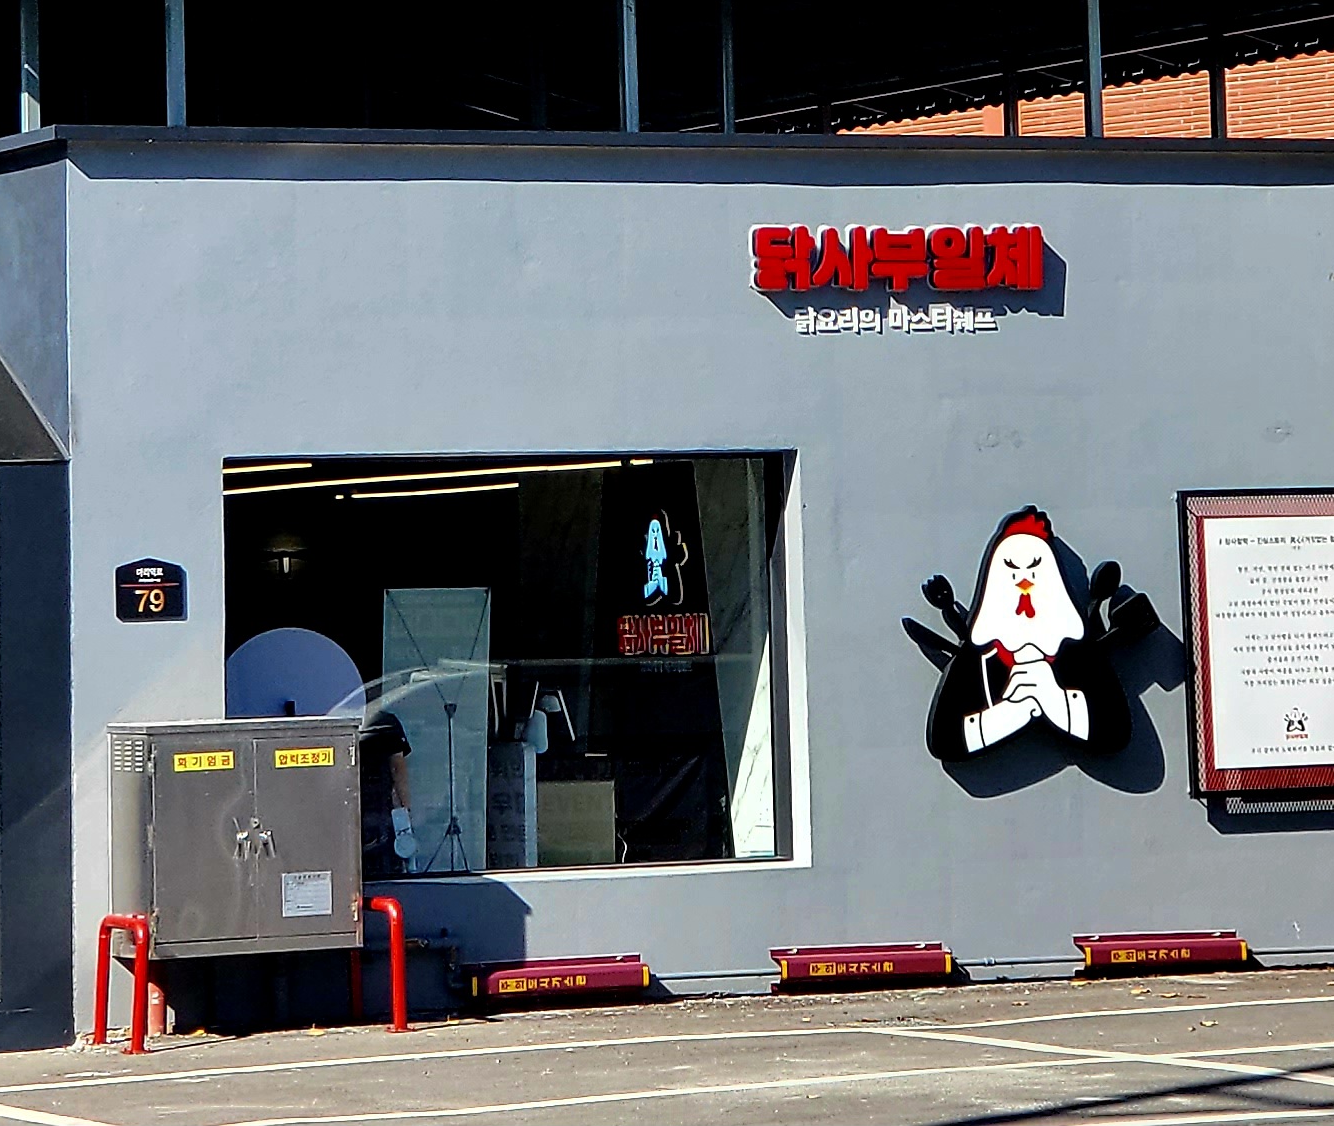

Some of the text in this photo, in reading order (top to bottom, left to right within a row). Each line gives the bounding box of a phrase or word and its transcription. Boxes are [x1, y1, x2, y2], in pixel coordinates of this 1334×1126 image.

[750, 224, 1044, 292] 닭사부일체
[794, 306, 997, 333] 닭요리의 마스터쉐프
[135, 588, 165, 613] 79
[278, 749, 331, 766] 압력조정기
